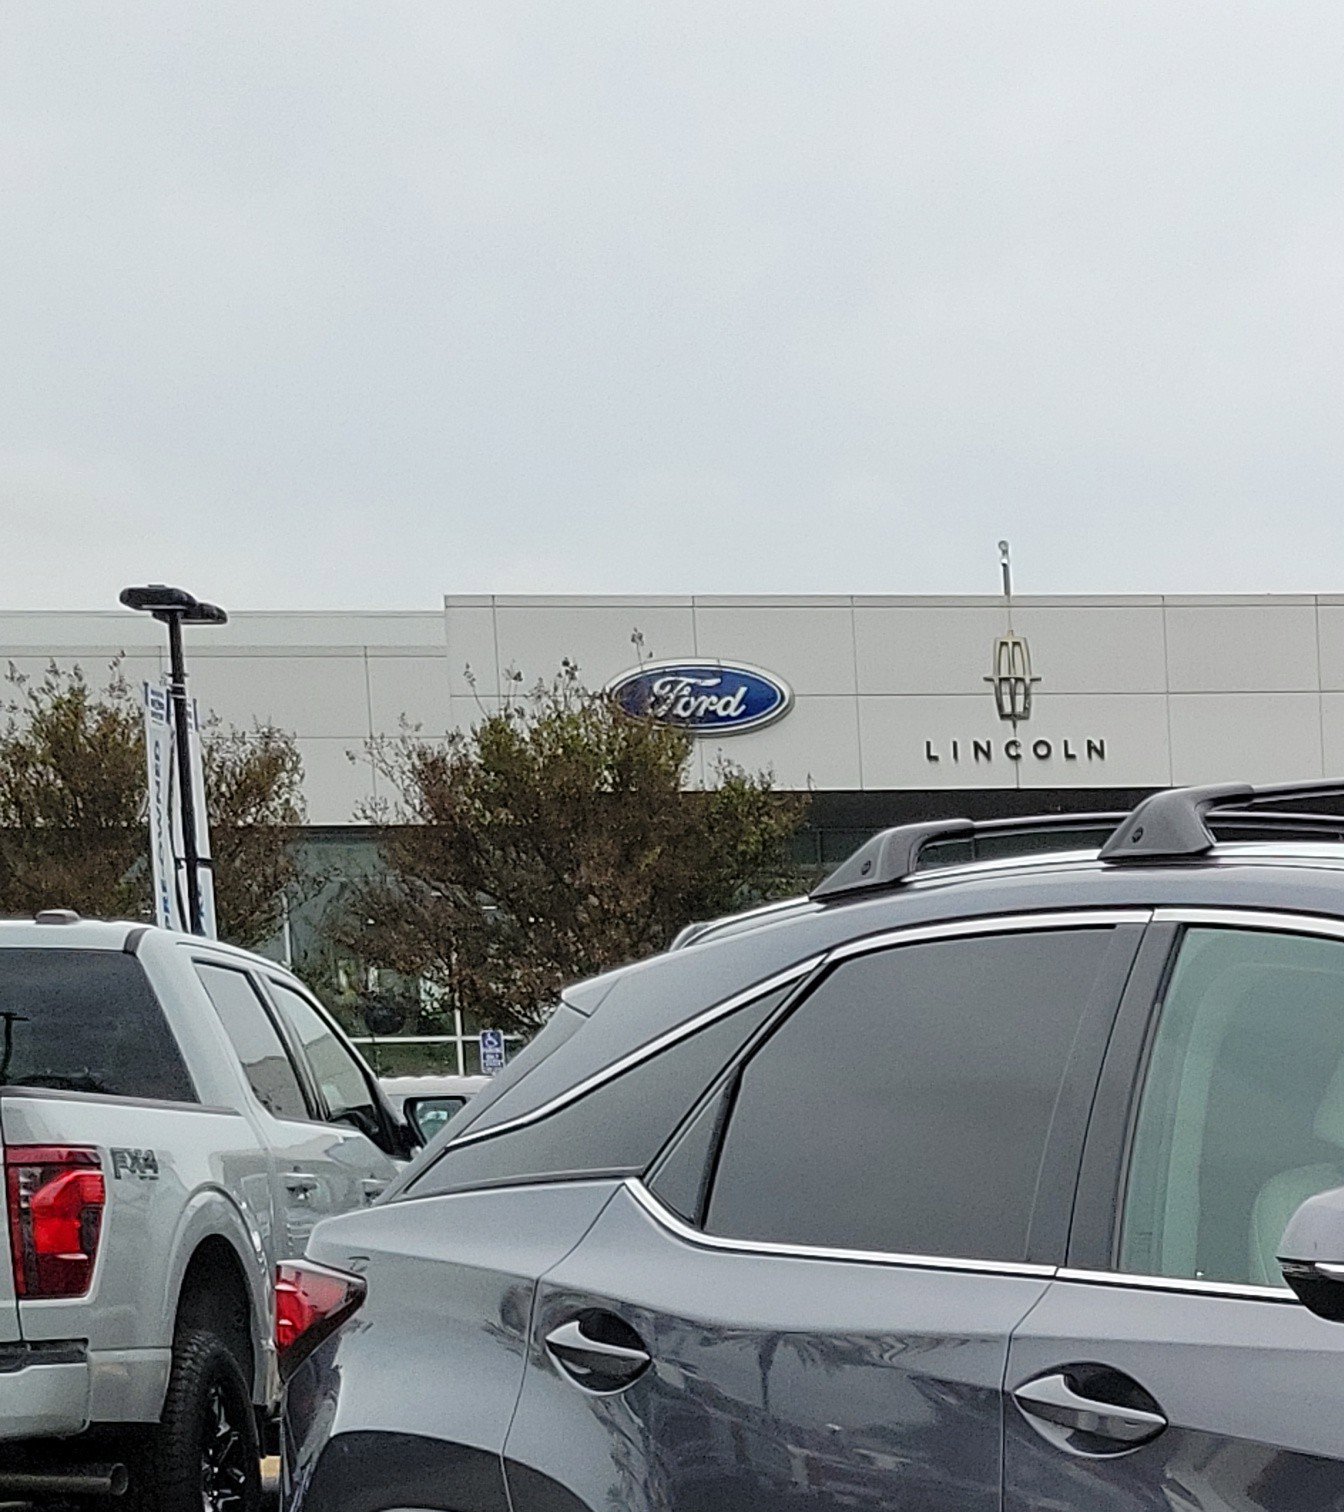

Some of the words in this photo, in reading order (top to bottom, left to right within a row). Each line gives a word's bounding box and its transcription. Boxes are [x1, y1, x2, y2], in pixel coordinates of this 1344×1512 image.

[651, 675, 749, 720] Ford
[925, 738, 1107, 763] LINCOLN
[109, 1146, 159, 1181] FX4
